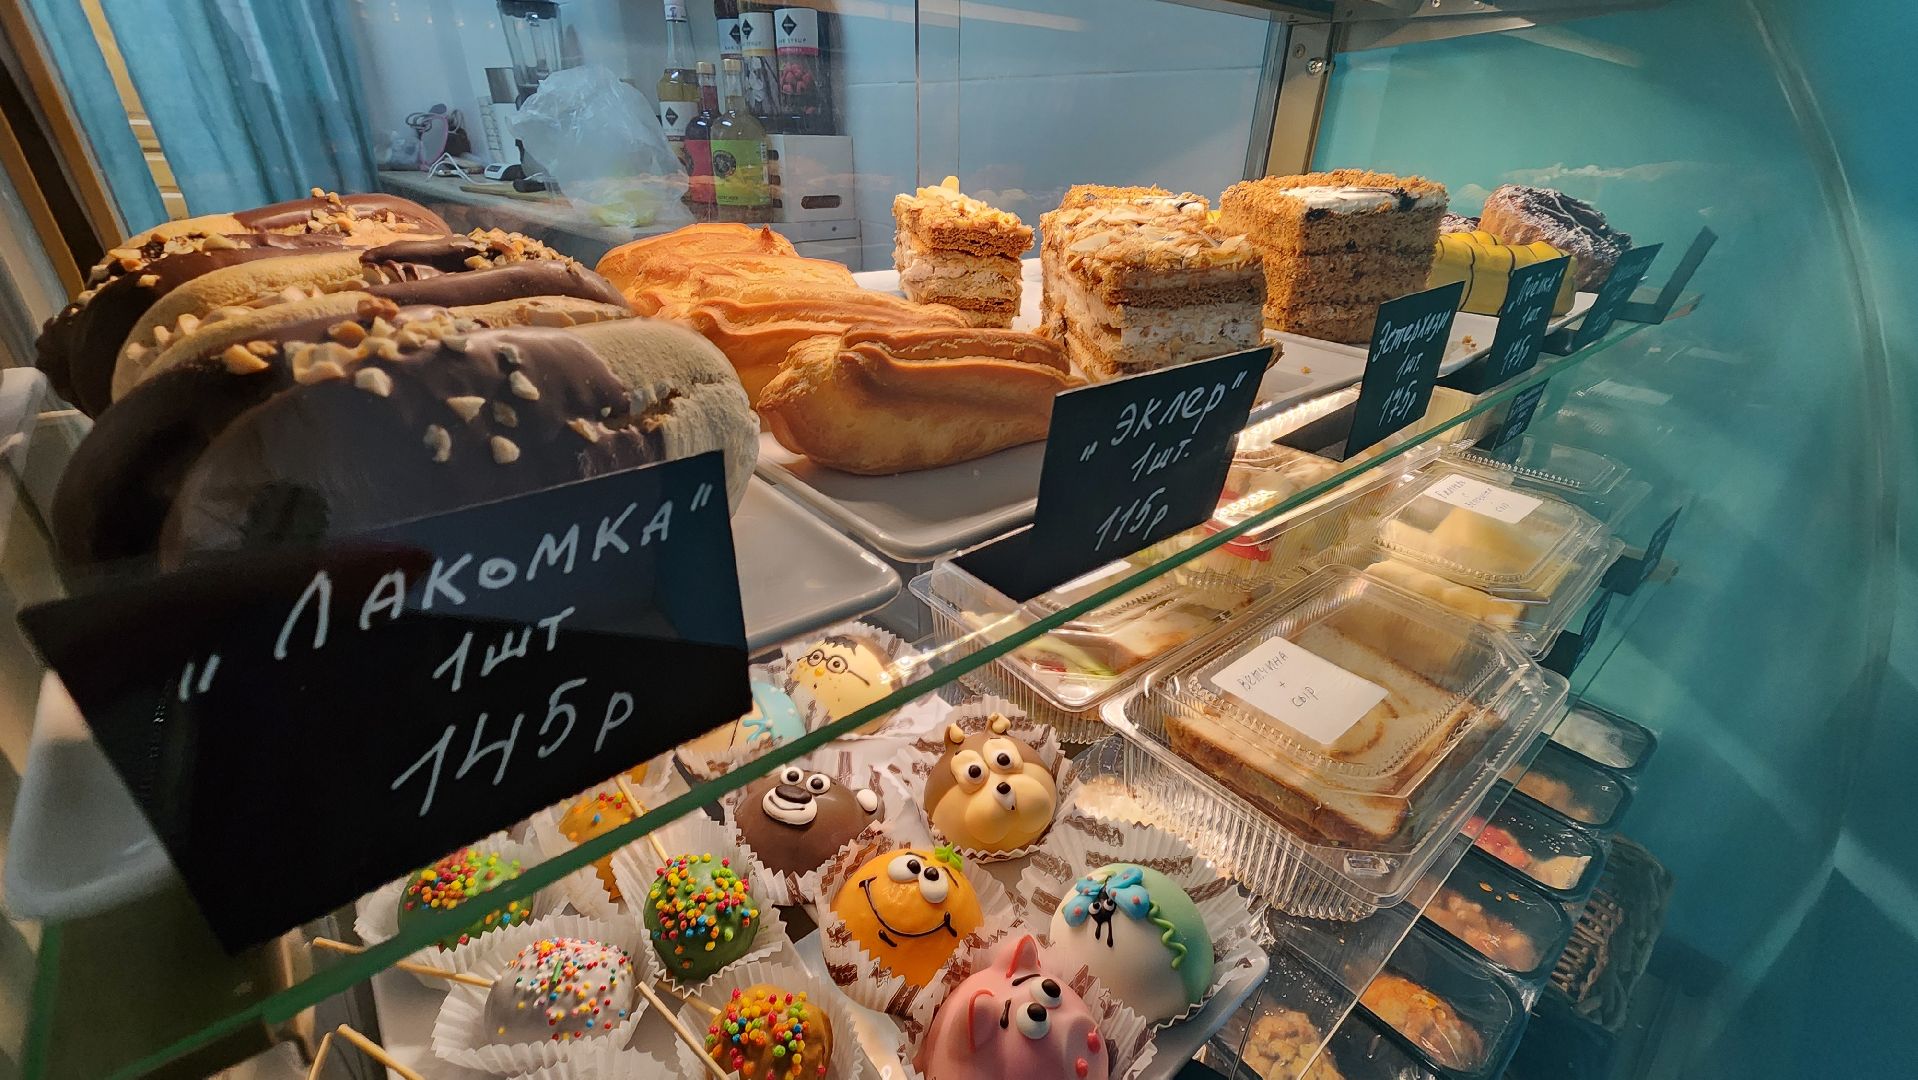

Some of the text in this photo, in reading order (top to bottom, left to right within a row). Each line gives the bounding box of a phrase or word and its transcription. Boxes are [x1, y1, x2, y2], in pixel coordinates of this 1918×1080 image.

[1372, 308, 1451, 362] Эстерхази
[1094, 487, 1169, 551] 115р
[432, 606, 576, 692] 1шт
[391, 677, 635, 817] 145р
